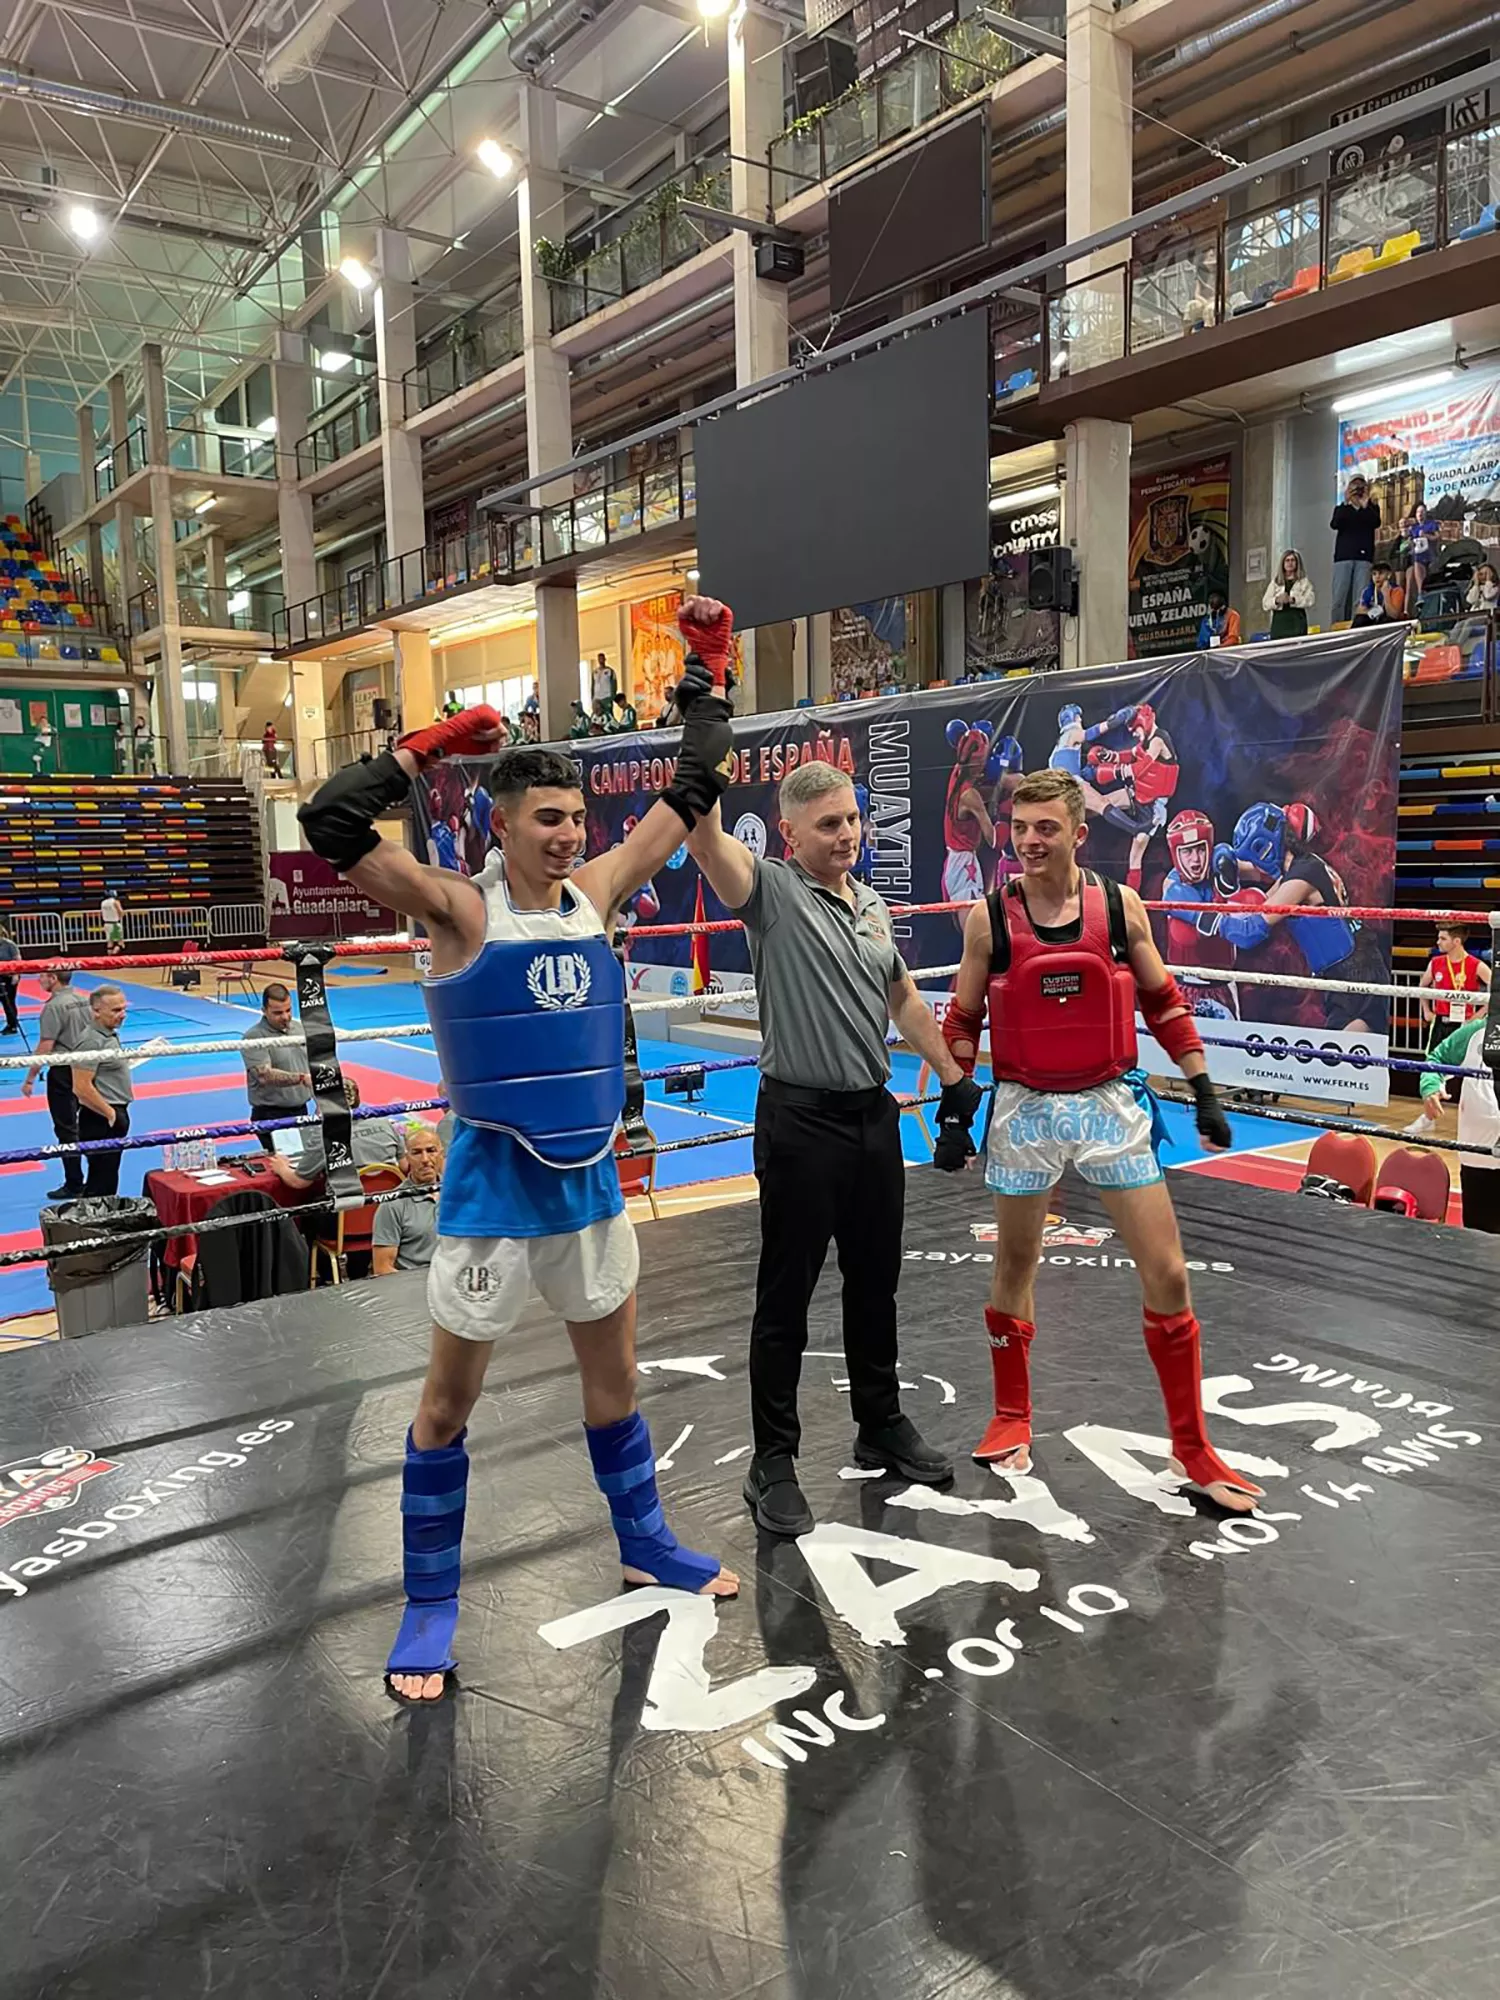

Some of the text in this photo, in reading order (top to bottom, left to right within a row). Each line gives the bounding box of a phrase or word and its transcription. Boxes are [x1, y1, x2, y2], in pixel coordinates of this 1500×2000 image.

[1428, 485, 1441, 495] 29
[1444, 482, 1457, 492] DE
[1141, 586, 1192, 610] ESPAÑA
[1128, 612, 1157, 628] UEVA
[1138, 623, 1197, 641] GUADALAJARA
[590, 756, 679, 795] CAMPEON
[293, 885, 355, 898] Ayuntamiento
[293, 897, 369, 915] Guadalajara
[48, 960, 82, 971] ZAYAS
[180, 952, 213, 965] ZAYAS
[1043, 975, 1079, 985] CUSTOM
[1346, 985, 1371, 993] ZAYAS
[1444, 992, 1472, 1001] ZAYAS
[301, 996, 325, 1009] ZAYAS
[409, 1027, 432, 1037] ZAYA
[681, 1063, 702, 1074] ZAYAS
[315, 1080, 340, 1091] ZAYAS
[1303, 1076, 1370, 1091] WWW.FEKM.ES
[41, 1142, 77, 1153] ZAYAS
[175, 1127, 207, 1138] ZAYAS
[405, 1101, 432, 1111] ZAYAS
[328, 1157, 353, 1171] ZAYAS
[67, 1237, 101, 1249] ZAYAS
[372, 1191, 400, 1203] ZAYAS
[536, 1373, 1383, 1732] ZAYAS
